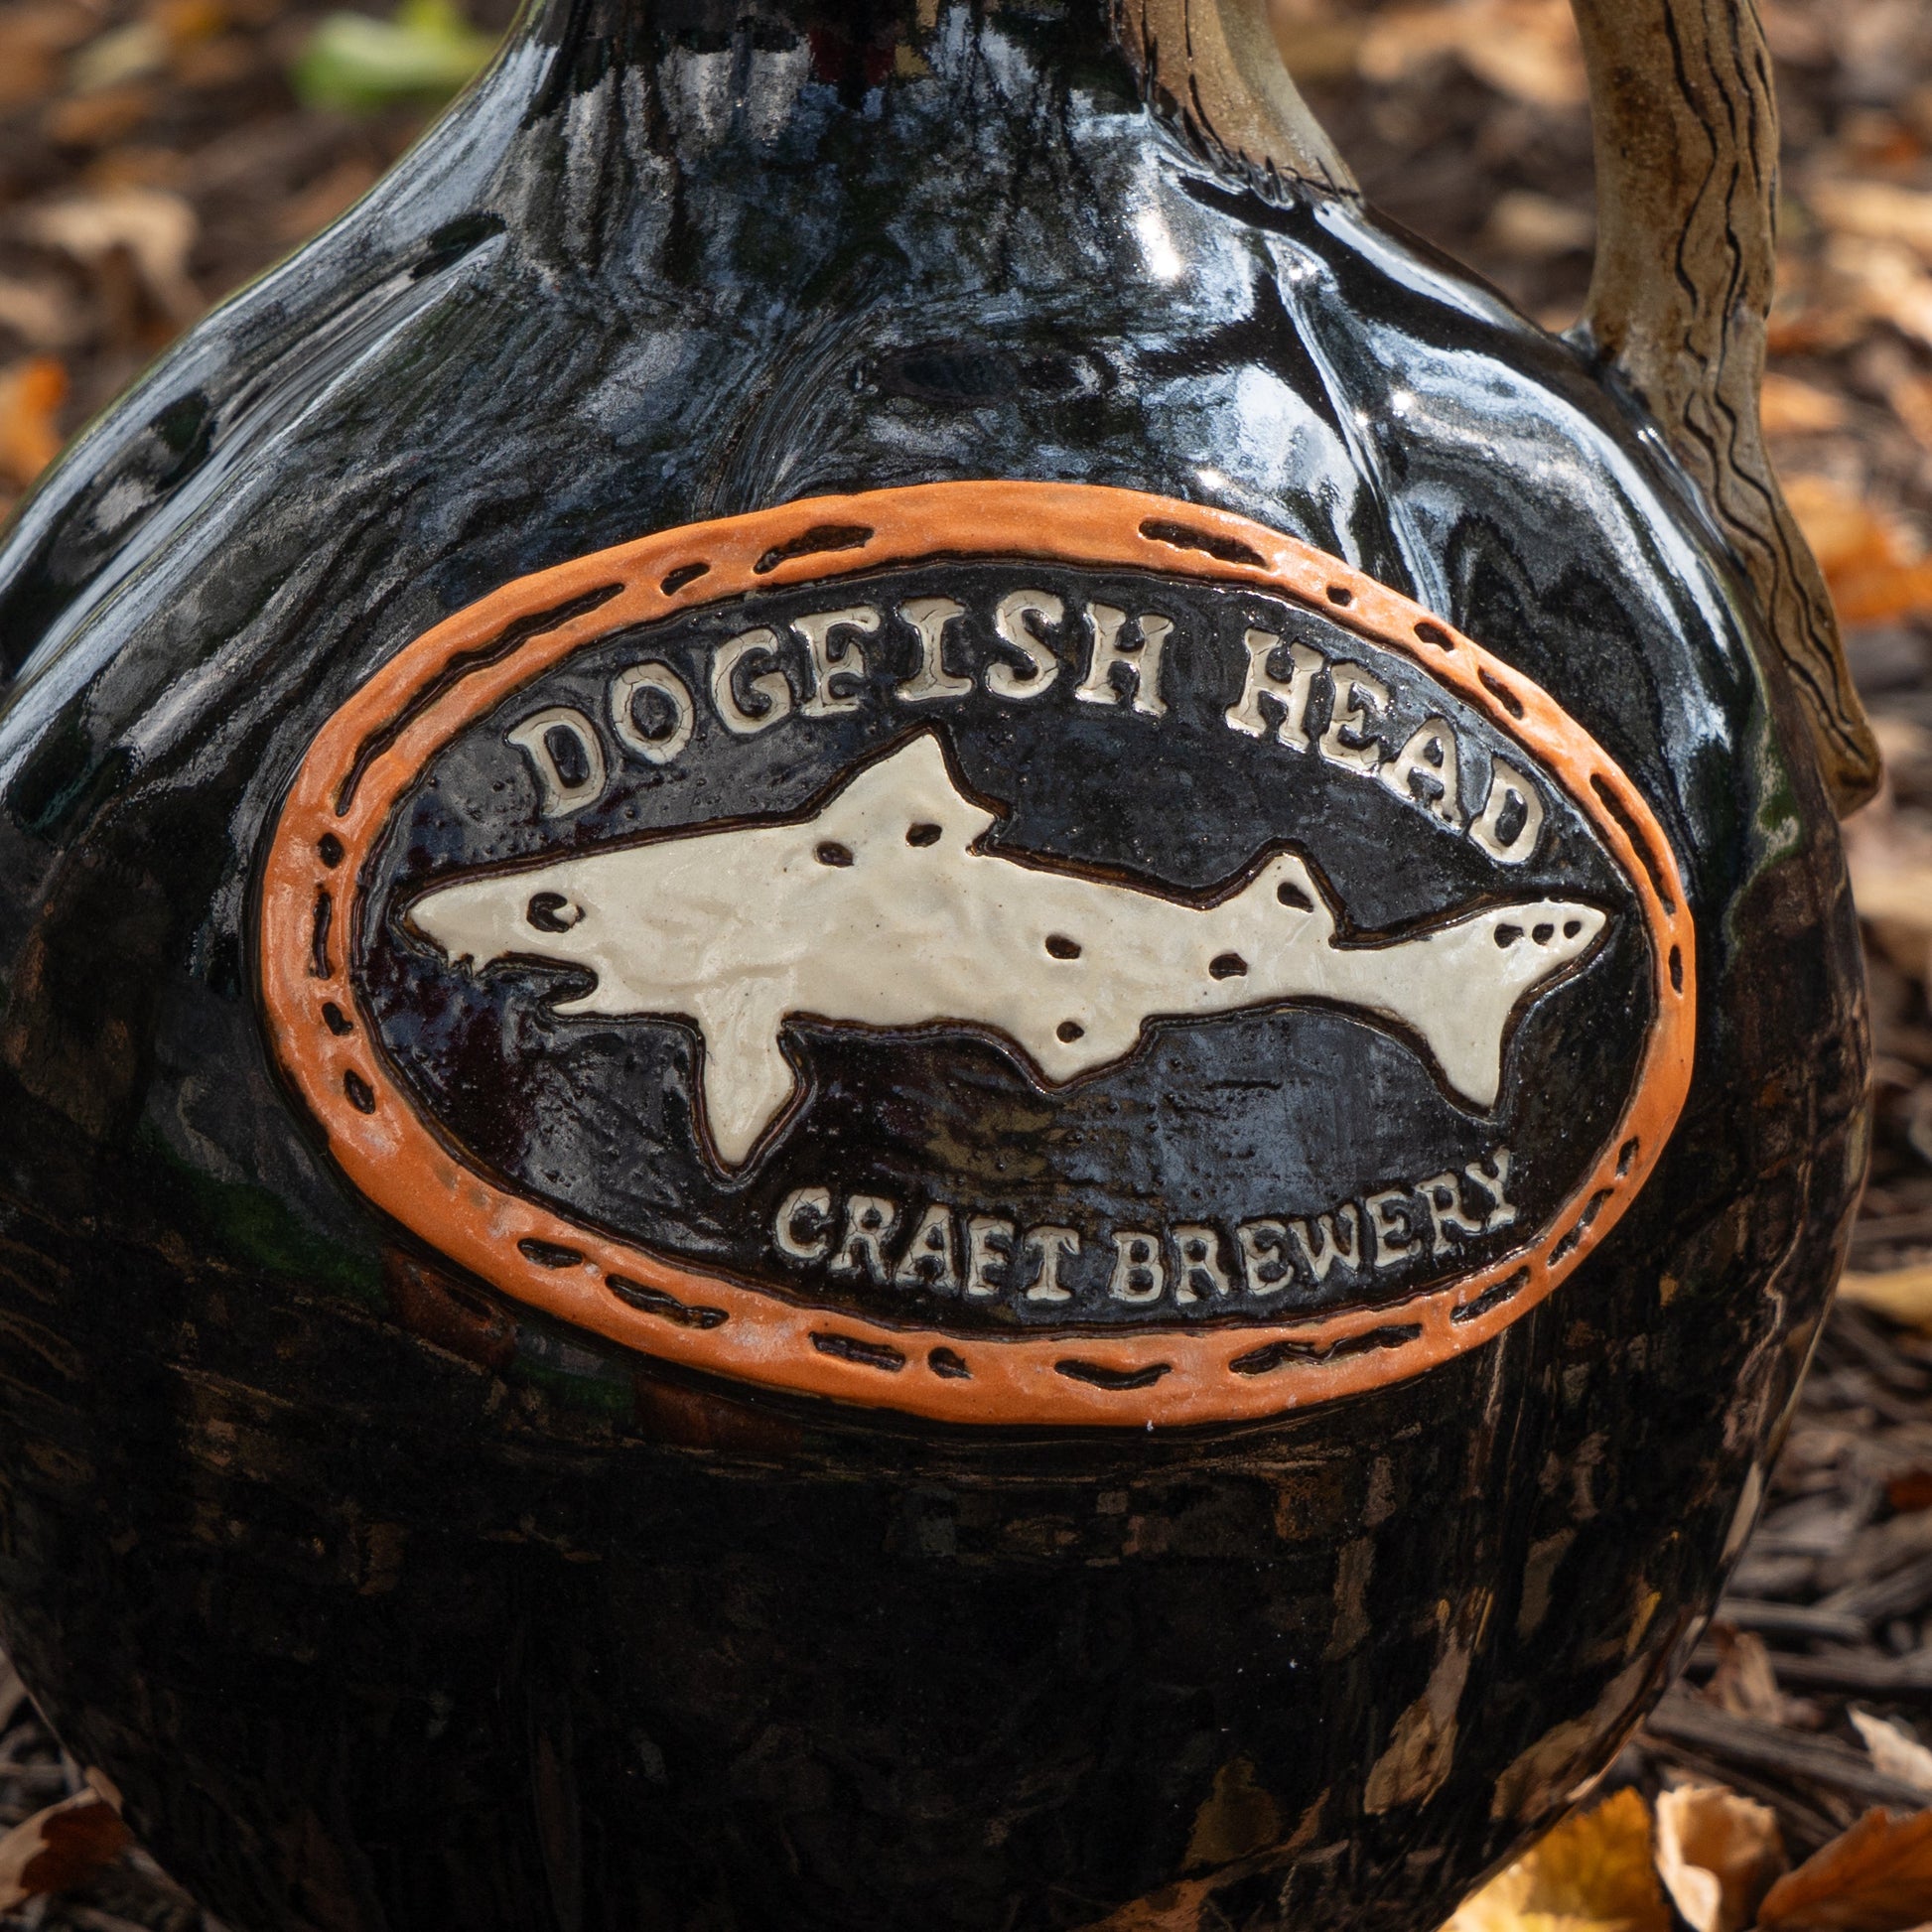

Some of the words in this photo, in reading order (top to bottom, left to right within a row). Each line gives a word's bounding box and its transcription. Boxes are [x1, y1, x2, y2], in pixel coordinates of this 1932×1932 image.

[504, 590, 1174, 818] DOGFISH
[1225, 627, 1545, 864] HEAD
[774, 1187, 1080, 1302] CRAFT
[1109, 1149, 1516, 1305] BREWERY
